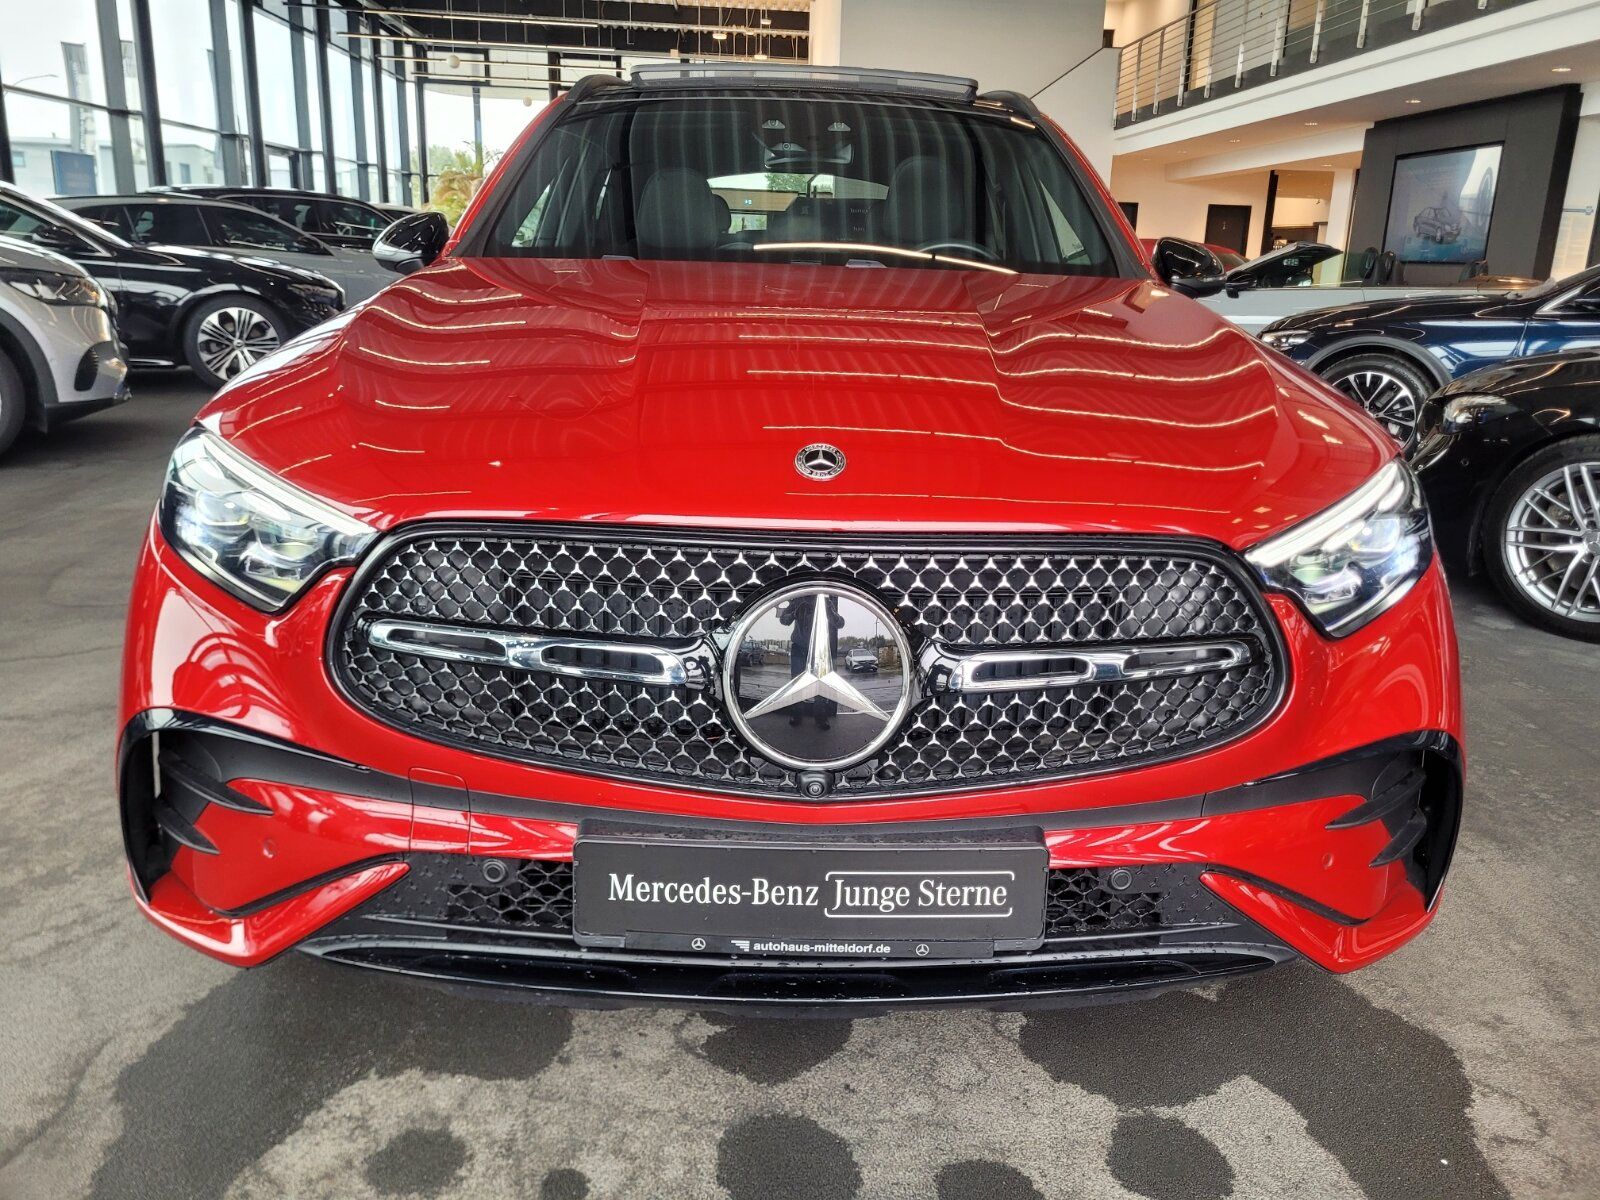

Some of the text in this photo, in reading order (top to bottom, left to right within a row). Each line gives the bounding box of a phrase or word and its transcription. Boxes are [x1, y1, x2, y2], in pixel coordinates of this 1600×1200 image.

[608, 872, 1008, 912] Mercedes-Benz Junge Sterne
[753, 939, 891, 955] autohaus-mitteldorf.de
